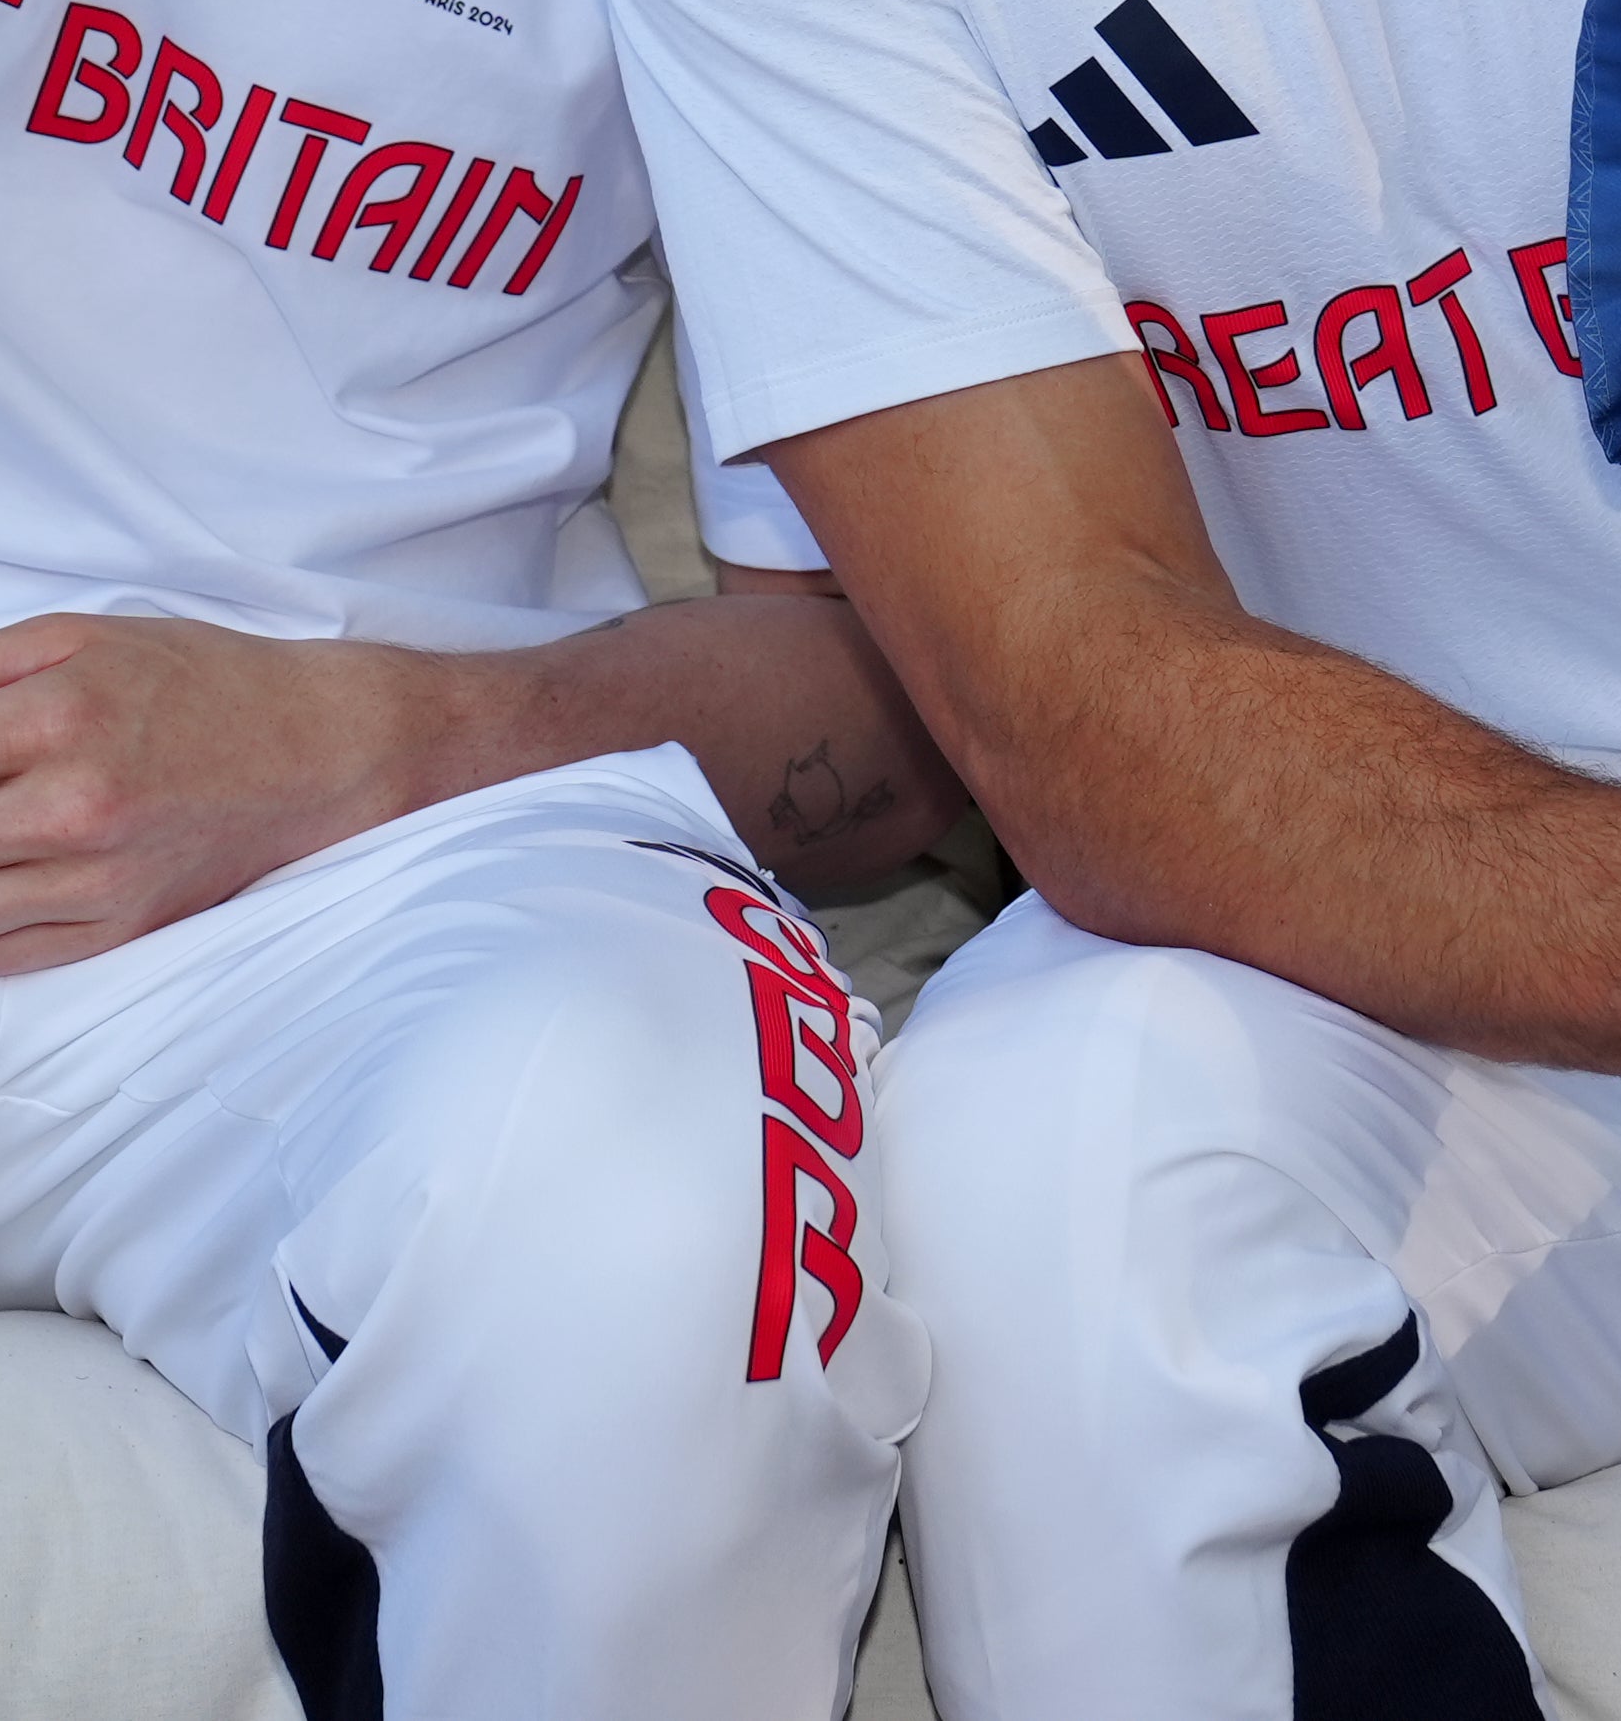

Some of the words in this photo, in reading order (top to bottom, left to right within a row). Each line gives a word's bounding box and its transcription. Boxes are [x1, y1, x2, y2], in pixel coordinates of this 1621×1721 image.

[468, 6, 514, 36] 2024
[25, 0, 584, 297] BRITAIN
[1123, 246, 1498, 438] REAT
